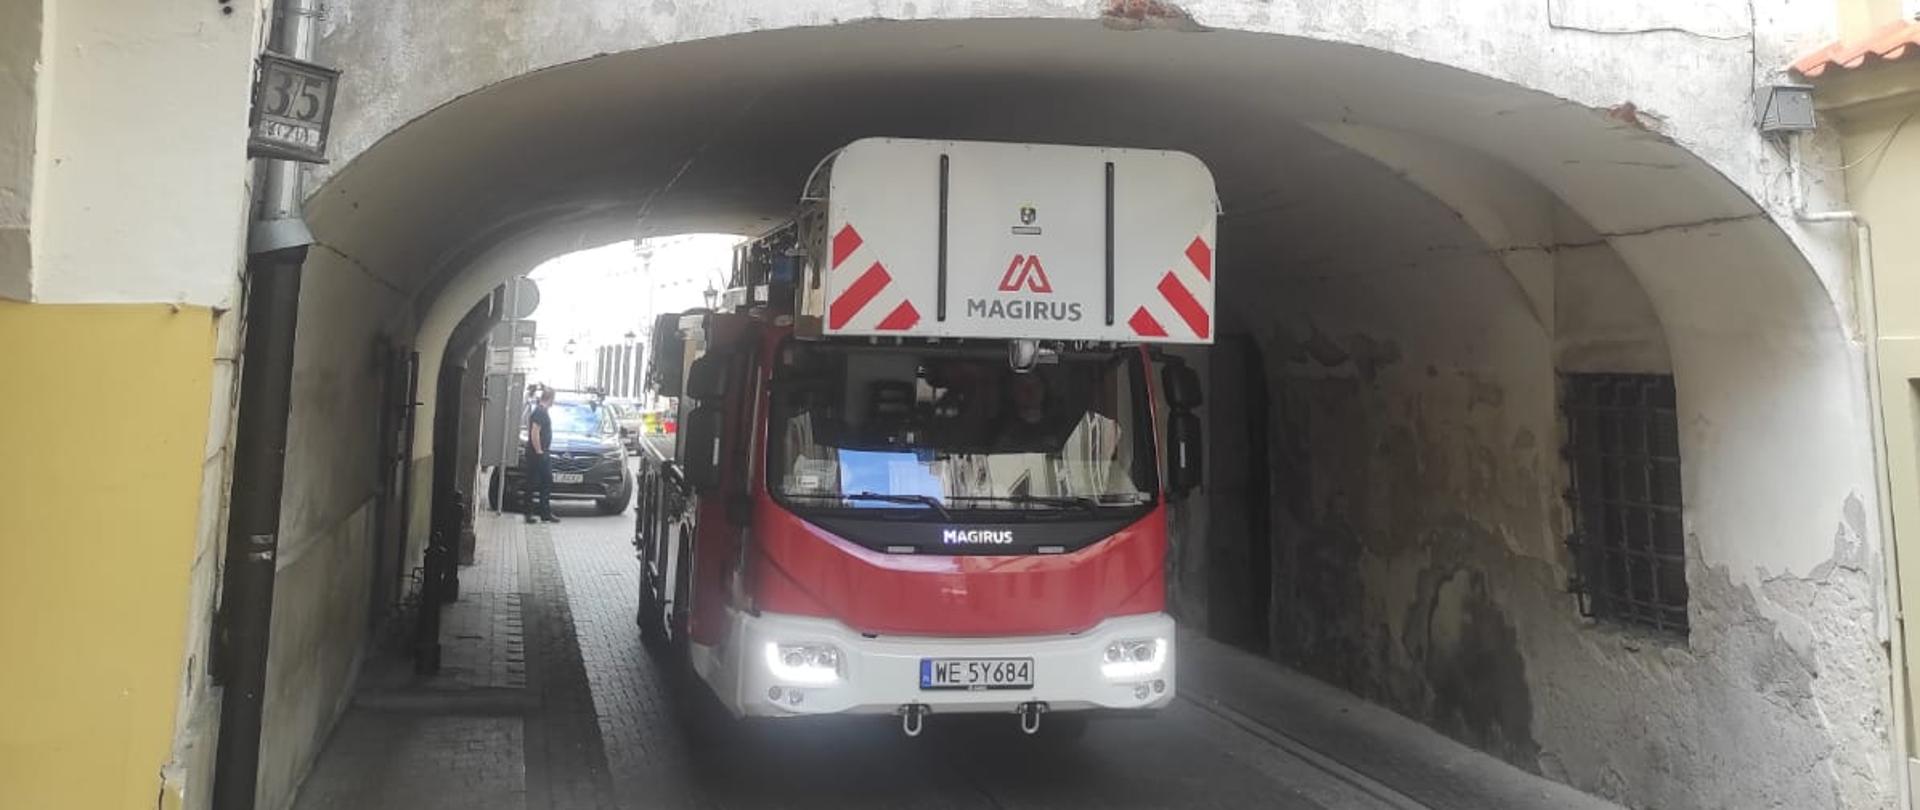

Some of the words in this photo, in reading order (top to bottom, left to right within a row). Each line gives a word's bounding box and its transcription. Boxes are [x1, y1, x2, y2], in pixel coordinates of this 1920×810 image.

[267, 68, 322, 120] 3/5
[966, 299, 1083, 322] MAGIRUS
[943, 529, 1013, 544] MAGIRUS
[935, 661, 961, 683] WE
[968, 661, 1029, 683] 5Y684
